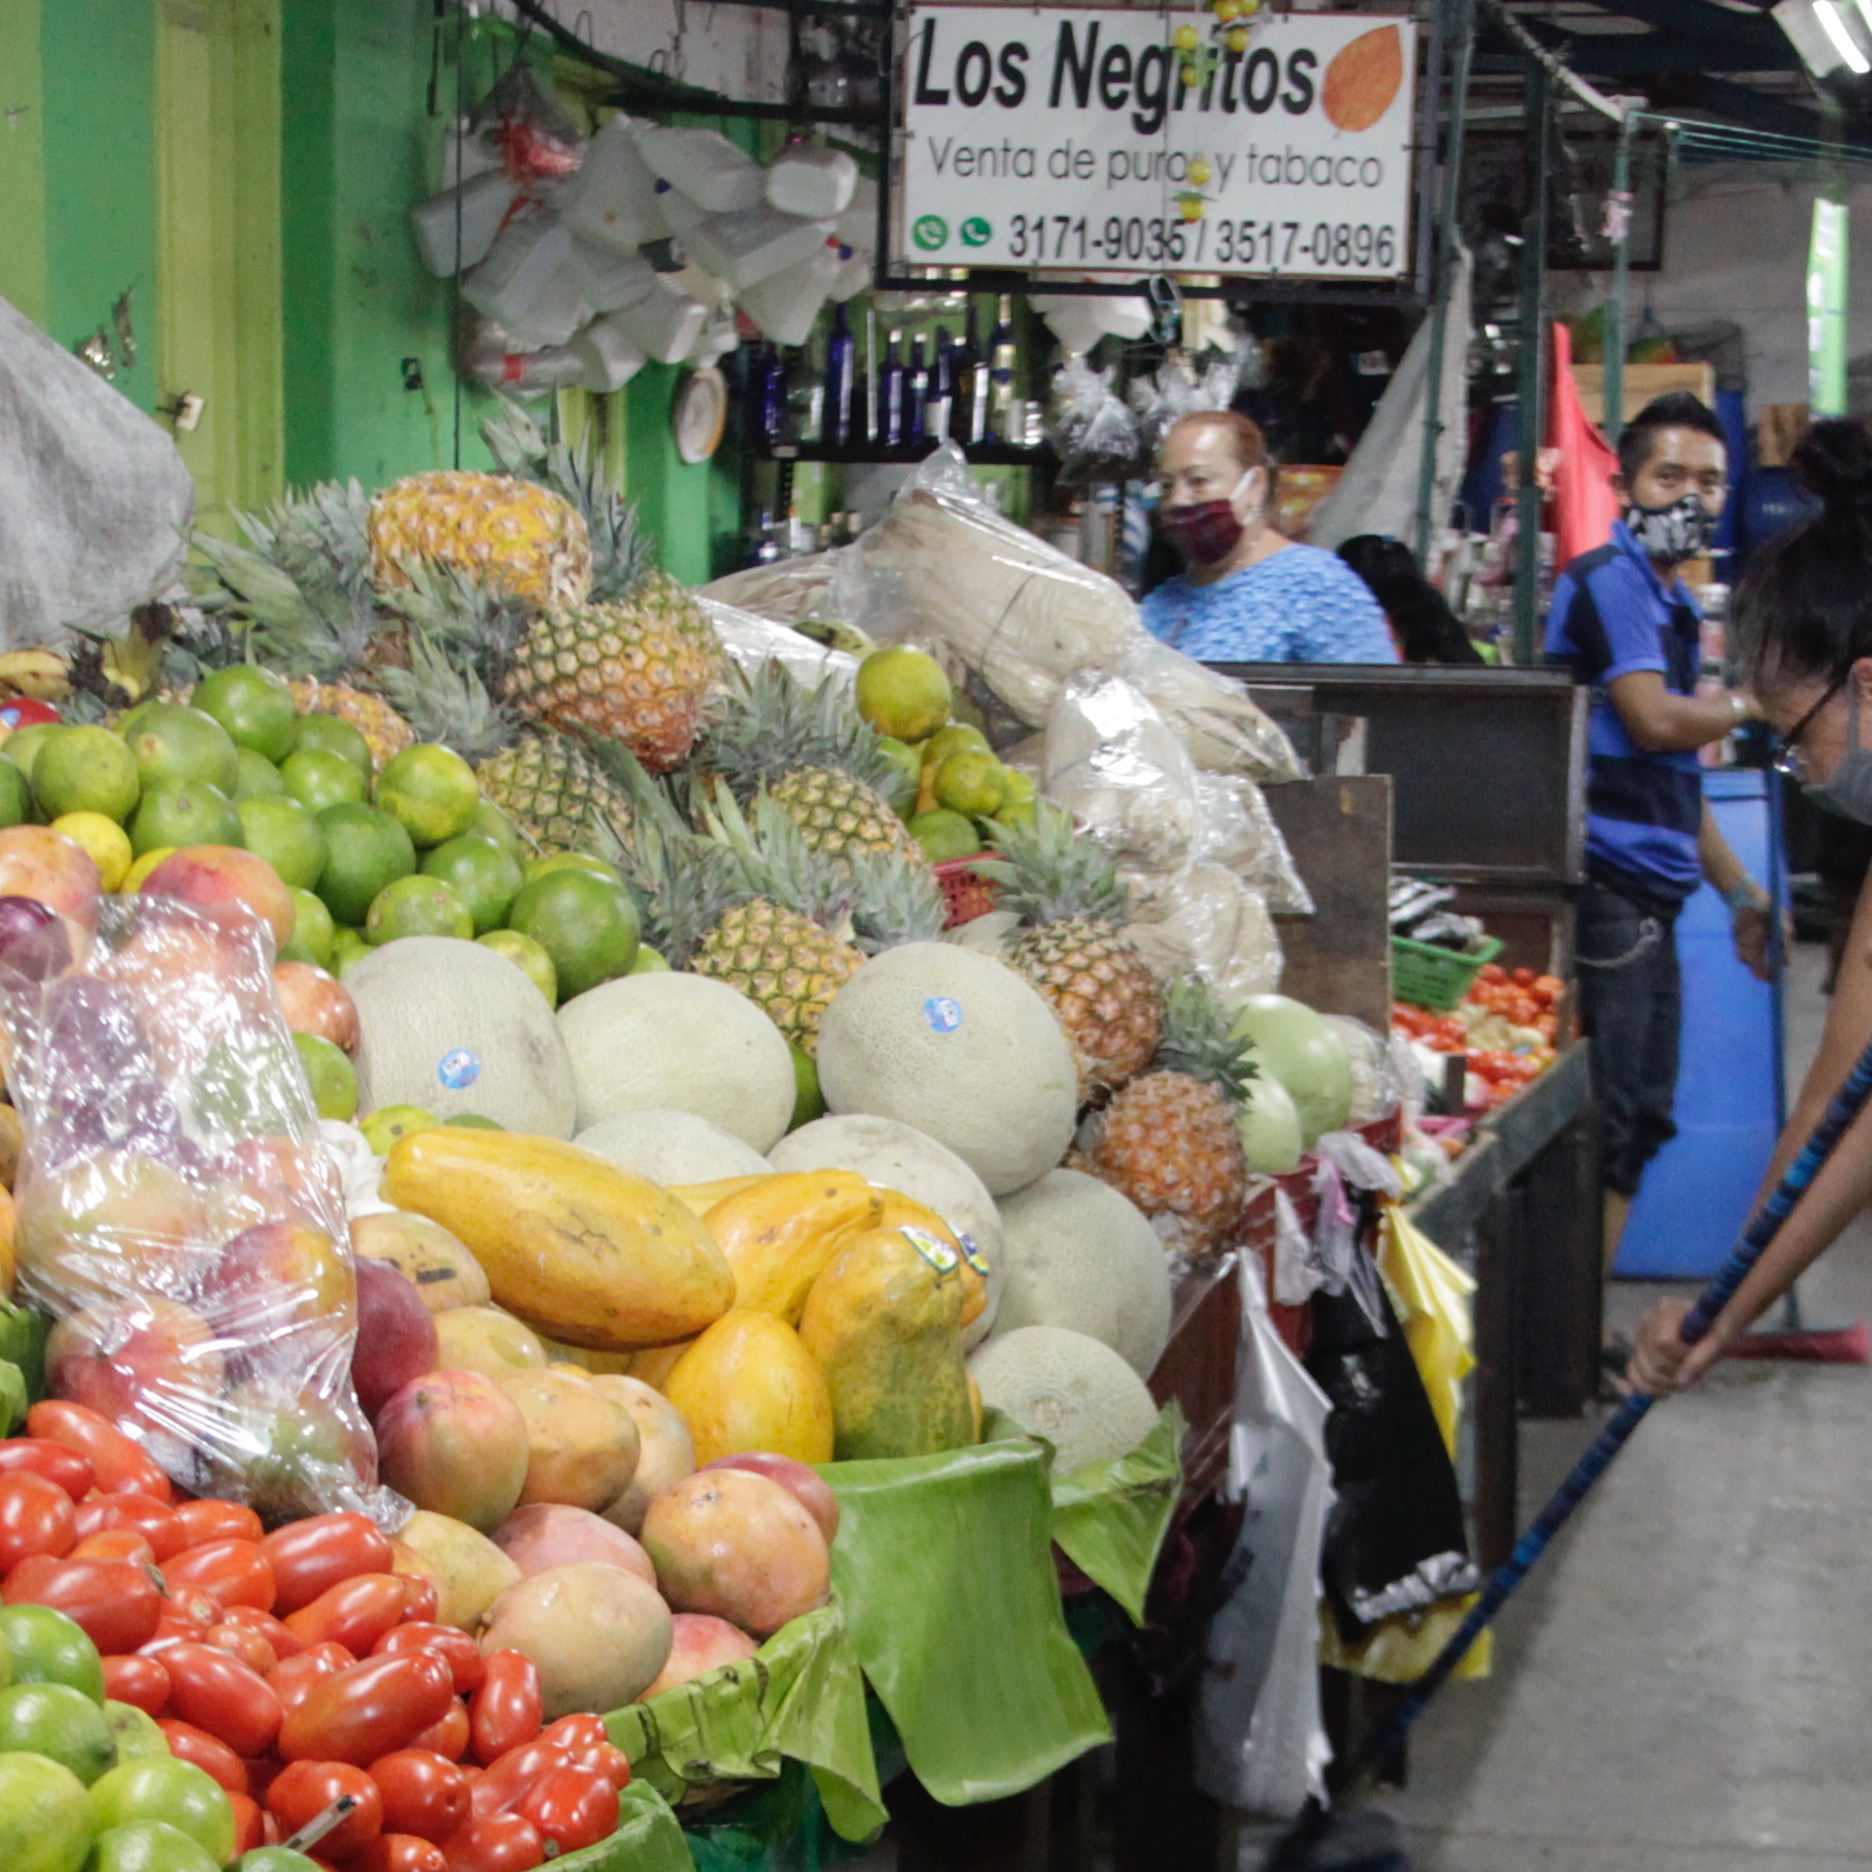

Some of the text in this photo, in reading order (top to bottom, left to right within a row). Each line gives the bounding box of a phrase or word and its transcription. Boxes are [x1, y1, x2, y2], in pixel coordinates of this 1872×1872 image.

[914, 17, 1030, 109] Los
[928, 136, 1383, 193] Venta de puro y tabaco
[1009, 214, 1187, 263] 3171-9035
[1215, 219, 1396, 268] 3517-0896
